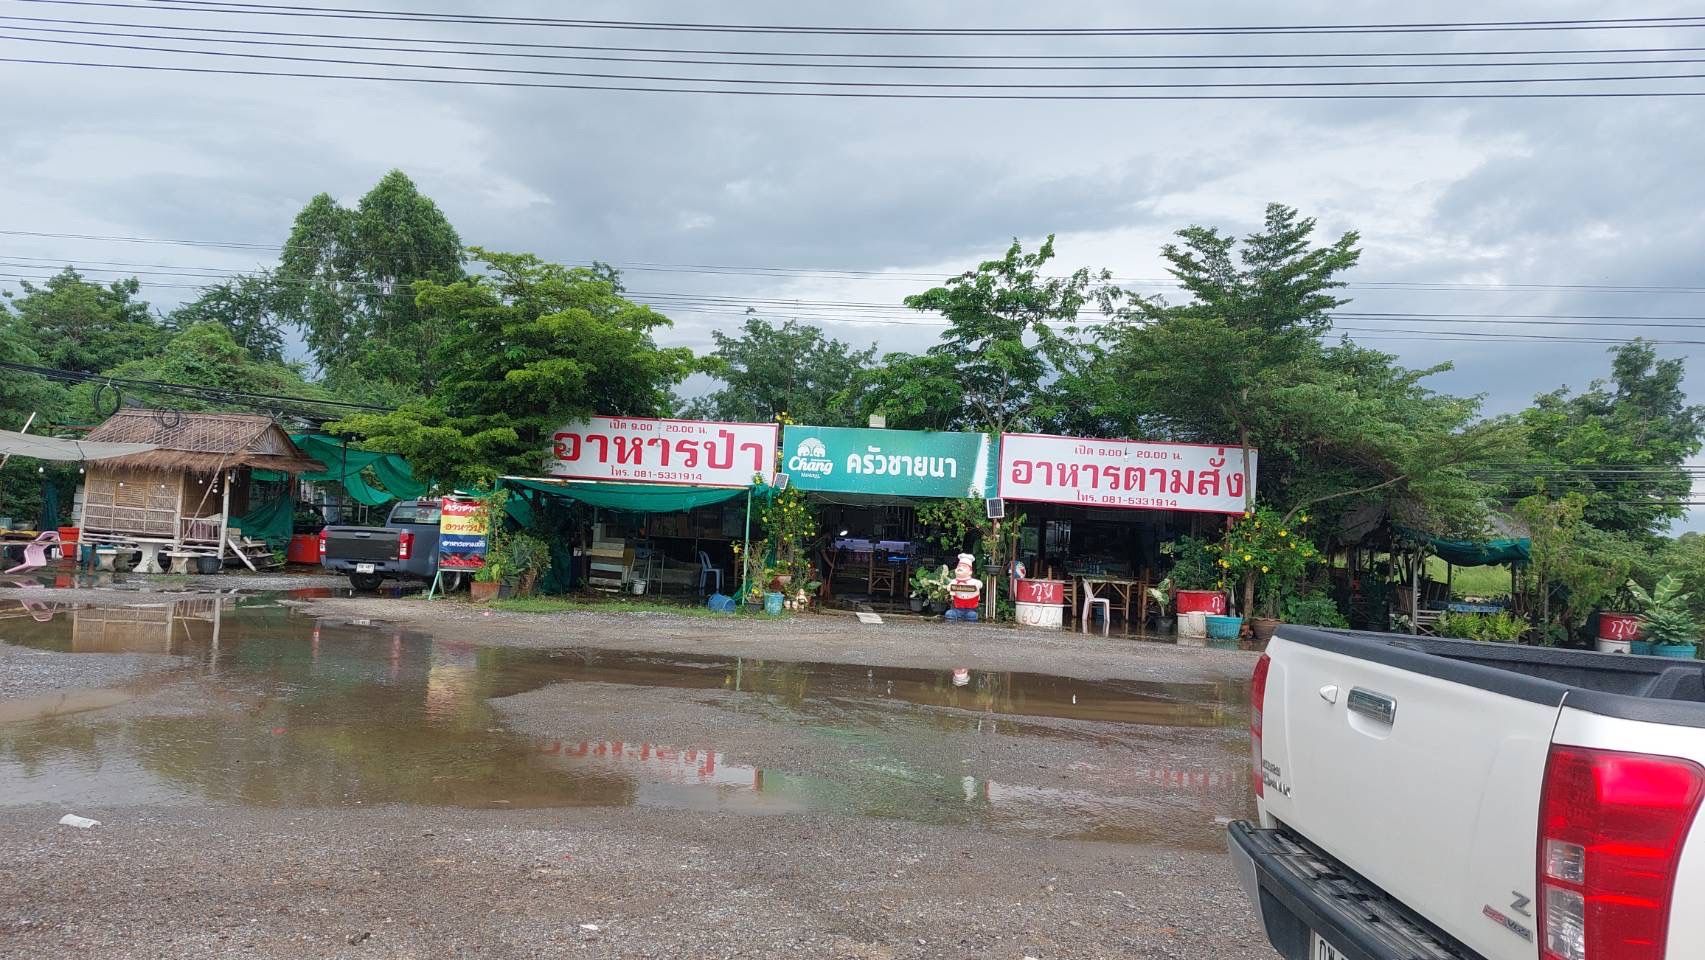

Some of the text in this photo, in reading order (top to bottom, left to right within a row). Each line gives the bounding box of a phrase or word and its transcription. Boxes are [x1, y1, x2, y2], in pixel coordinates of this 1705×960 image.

[609, 419, 627, 430] เปิด
[631, 422, 653, 432] 9.00
[665, 424, 694, 434] 20.00
[553, 429, 763, 471] อาหารป่า
[1074, 444, 1093, 456] เปิด
[1098, 448, 1122, 457] 9.00
[1136, 450, 1168, 460] 20.00
[788, 455, 834, 475] Chang
[847, 445, 957, 478] ครัวชายนา
[610, 464, 702, 480] โทร. 081-5331914
[1011, 448, 1244, 498] อาหารตามสั่ง
[1077, 489, 1177, 507] โทร. 081-5331914
[1510, 890, 1531, 917] Z
